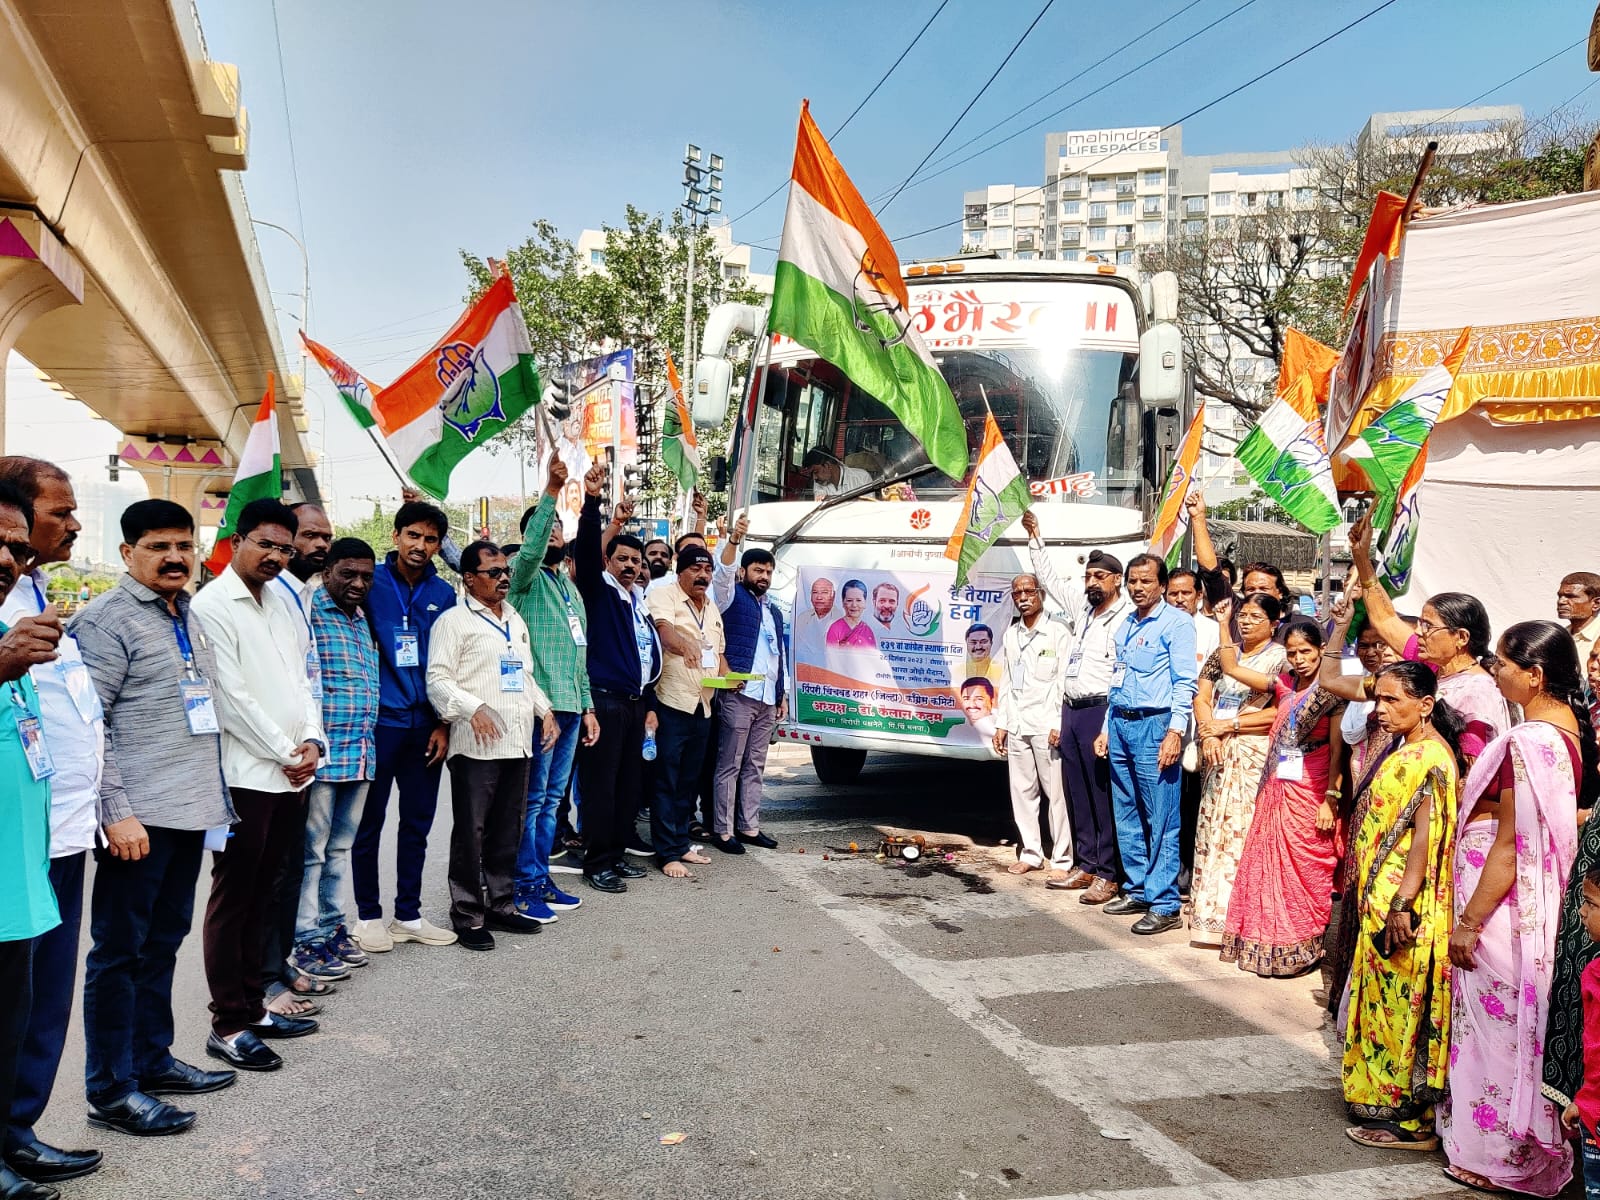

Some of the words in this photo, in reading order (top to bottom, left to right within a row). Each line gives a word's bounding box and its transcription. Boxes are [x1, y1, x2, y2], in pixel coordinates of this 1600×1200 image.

[1069, 129, 1159, 144] mahindra
[1069, 141, 1158, 155] LIFESPACES
[965, 586, 1004, 603] तैयार
[949, 603, 982, 622] हम
[924, 644, 949, 654] स्थापना
[950, 645, 963, 655] दिन
[853, 690, 869, 699] शहर
[929, 696, 955, 707] कमिटी
[813, 701, 846, 714] अध्यक्ष
[914, 711, 943, 724] कदम
